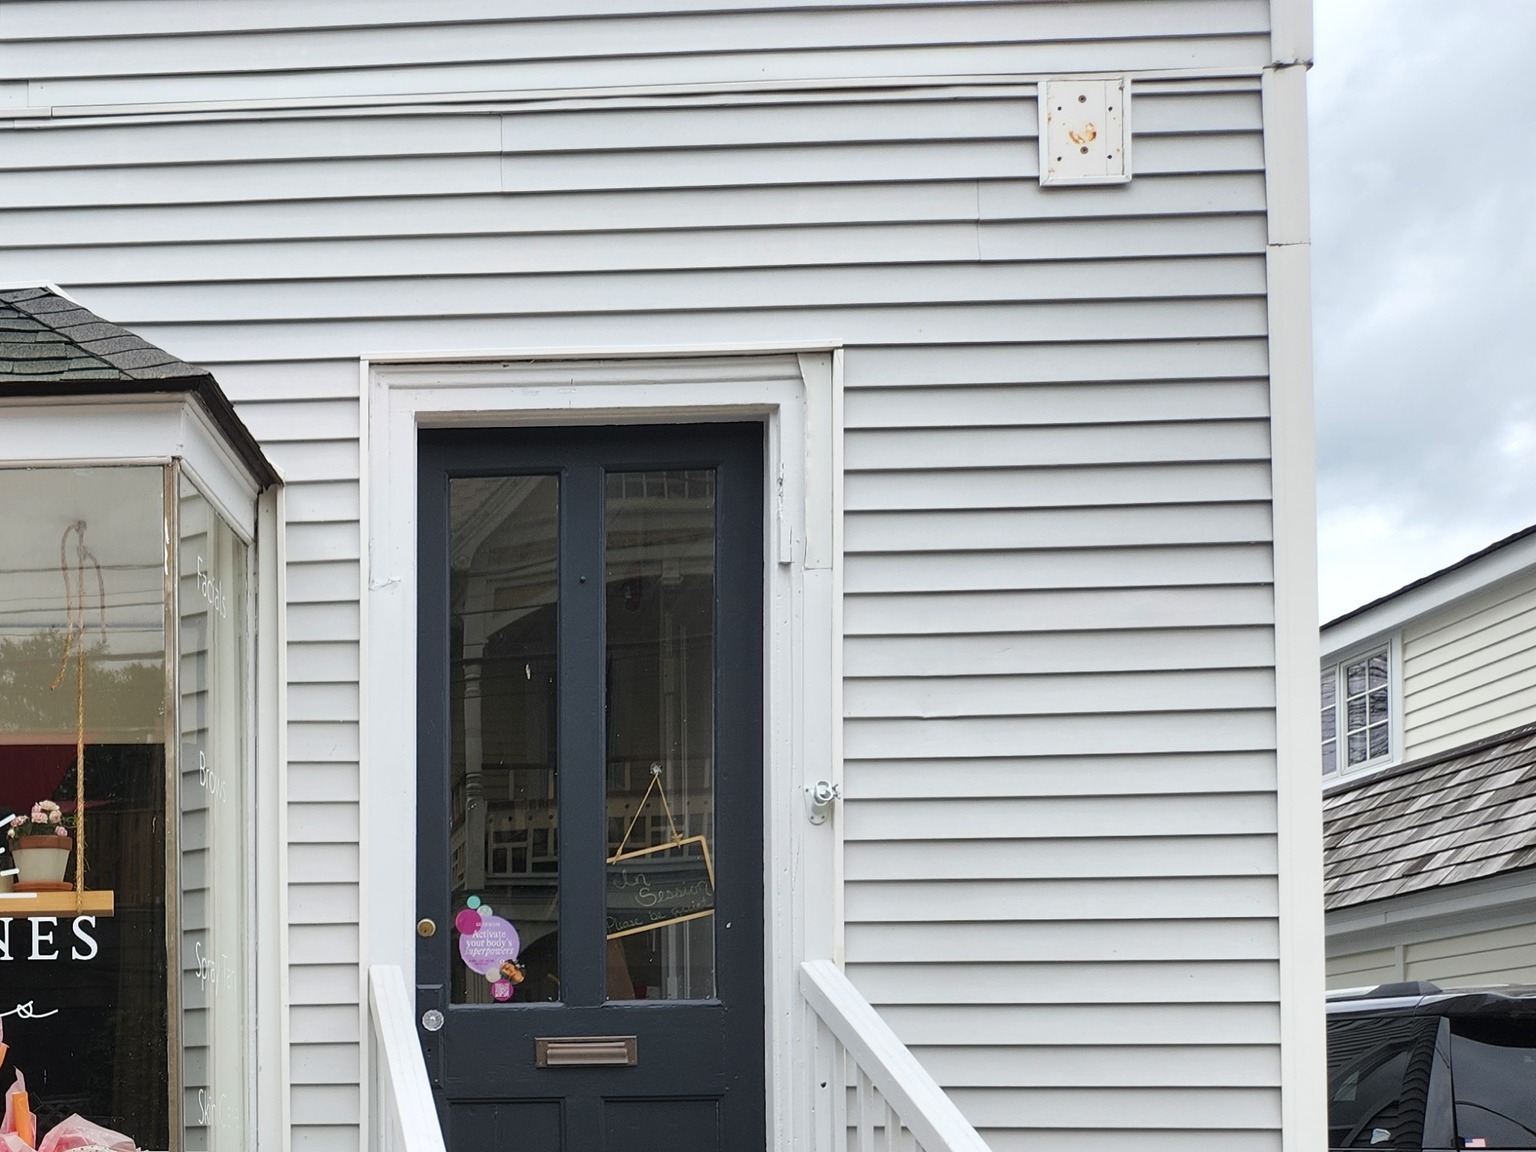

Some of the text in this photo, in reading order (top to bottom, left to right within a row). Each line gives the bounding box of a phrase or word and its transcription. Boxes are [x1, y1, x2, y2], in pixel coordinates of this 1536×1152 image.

[196, 555, 227, 618] Facials
[199, 750, 227, 803] Brows
[613, 869, 651, 889] In
[635, 881, 712, 907] Session
[472, 929, 507, 939] Activate
[606, 915, 644, 932] Please
[648, 910, 666, 921] be
[466, 938, 513, 949] your body's
[195, 941, 220, 998] Spray
[198, 1088, 217, 1125] Skin
